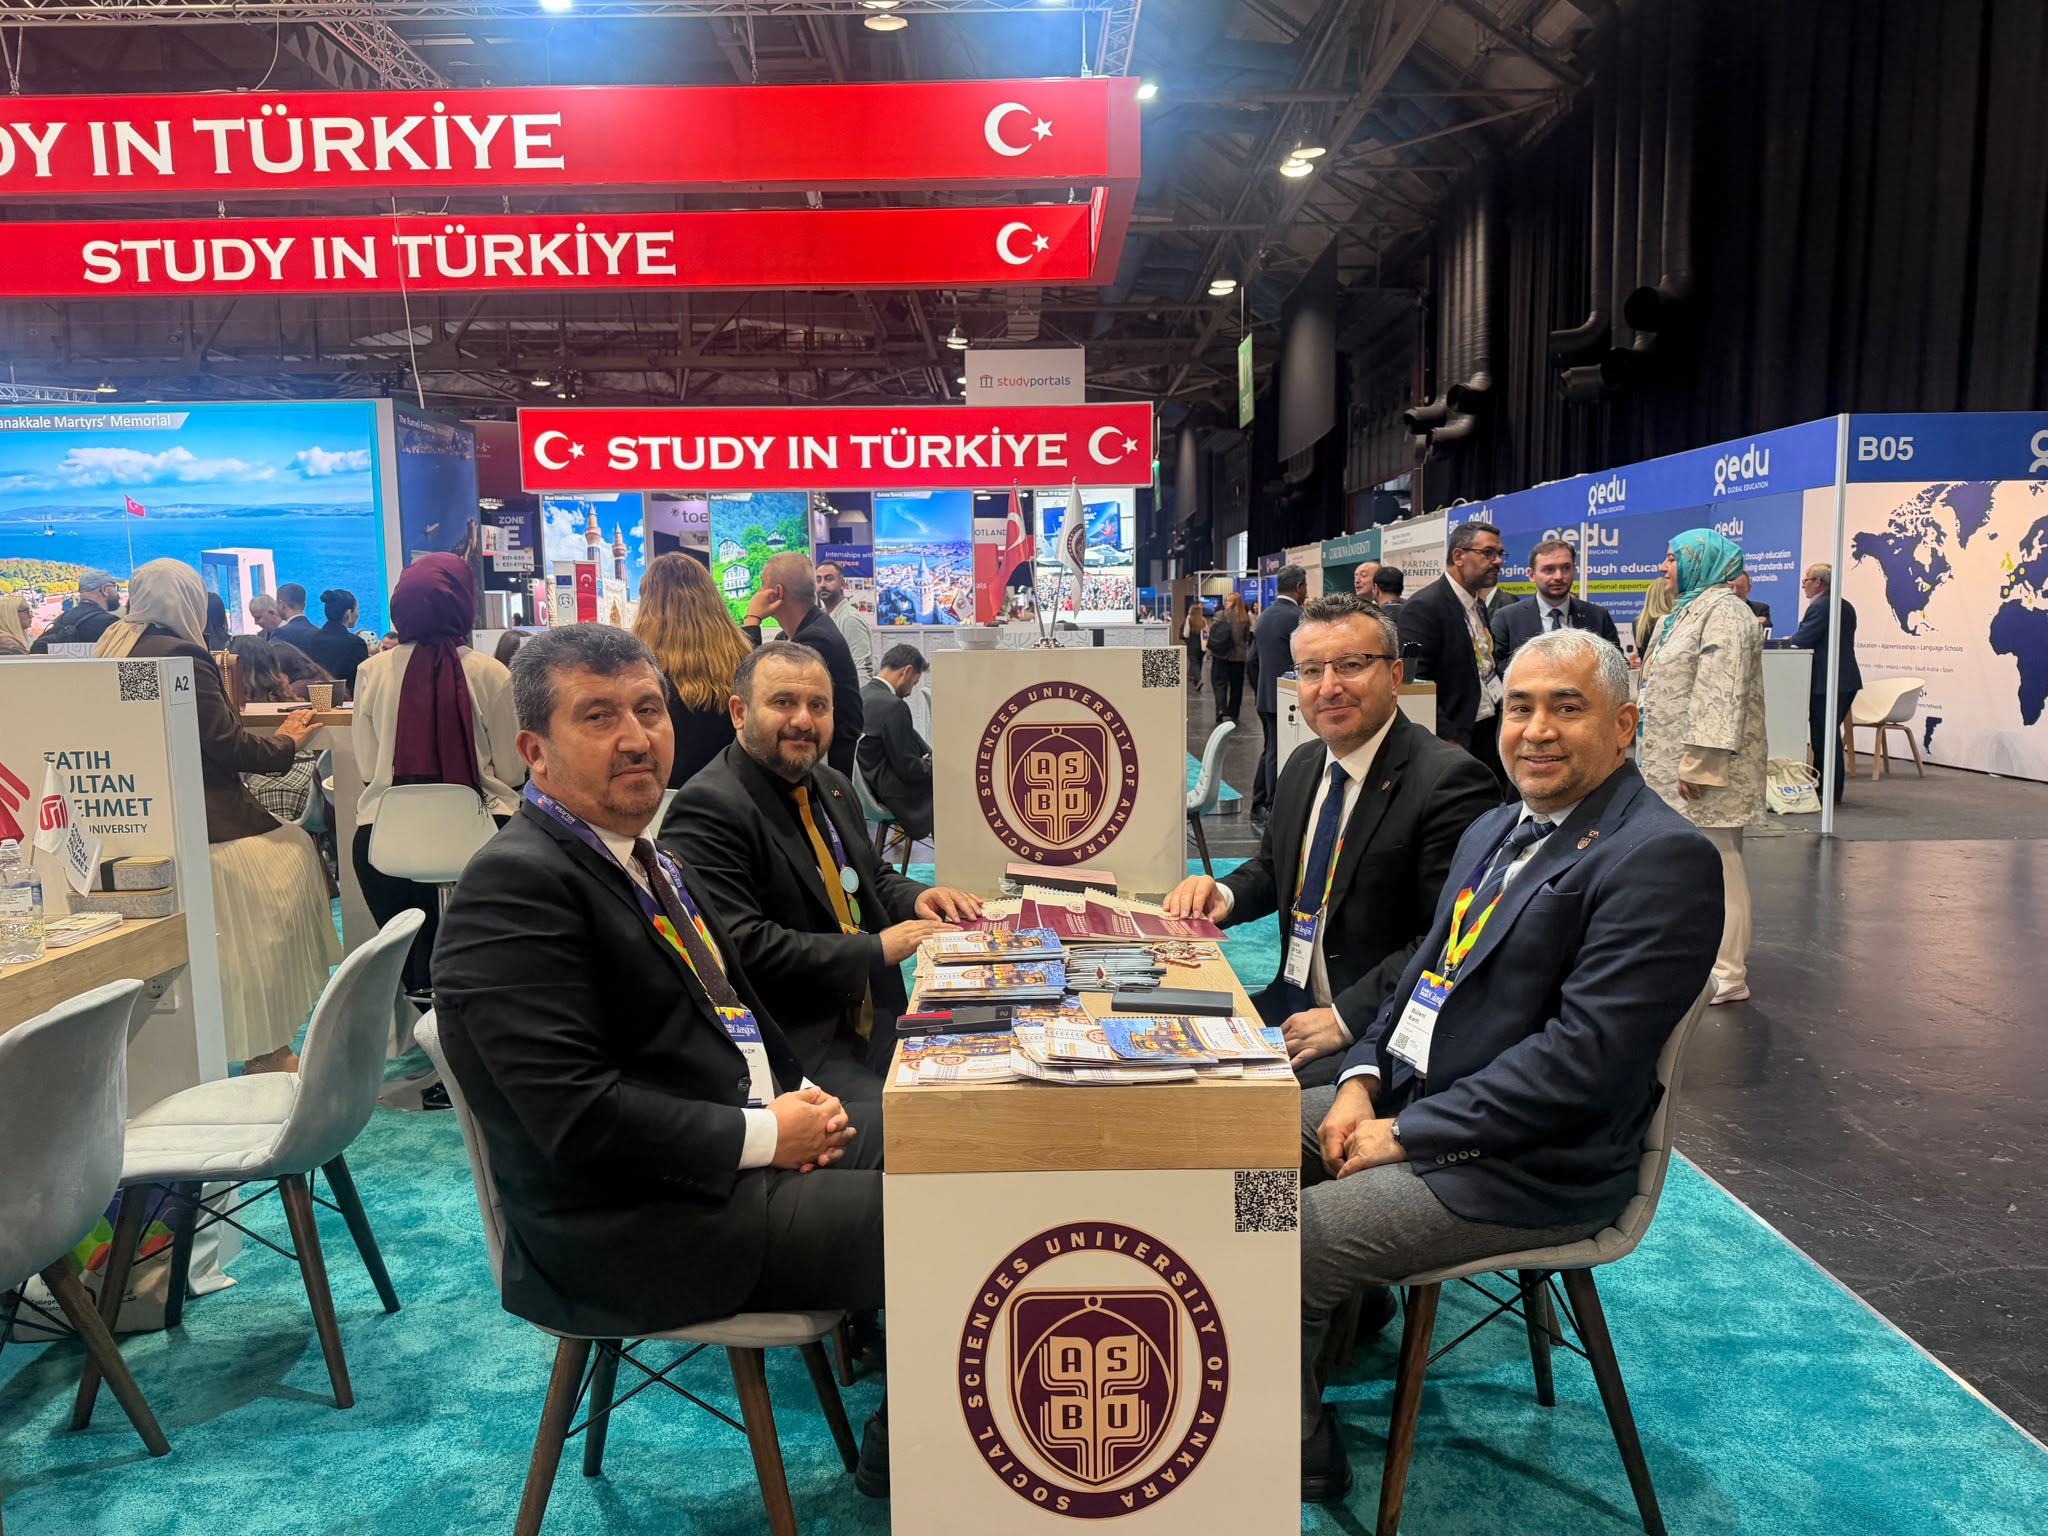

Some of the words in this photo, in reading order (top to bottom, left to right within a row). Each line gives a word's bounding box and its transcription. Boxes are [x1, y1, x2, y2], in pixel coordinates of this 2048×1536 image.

[88, 120, 176, 177] IN
[192, 100, 565, 175] TÜRKİYE
[81, 236, 296, 284] STUDY
[311, 235, 378, 280] IN
[391, 221, 677, 278] TÜRKİYE
[997, 375, 1072, 388] studyportals
[111, 413, 171, 428] Memorial
[607, 434, 776, 471] STUDY
[788, 434, 839, 469] IN
[850, 426, 1069, 470] TÜRKİYE
[1857, 435, 1915, 462] B05
[1713, 442, 1770, 497] gedu
[1587, 473, 1627, 517] gedu
[1727, 484, 1743, 494] GLOBAL
[1743, 480, 1769, 492] EDUCATION
[498, 516, 525, 525] ZONE
[504, 525, 521, 546] E
[825, 551, 861, 559] Internships
[1402, 559, 1439, 568] PARTNER
[1765, 550, 1792, 559] education
[1784, 560, 1795, 570] and
[1402, 568, 1442, 577] BENEFITS
[1880, 643, 1916, 651] Apprenticeships
[1920, 644, 1944, 653] Language
[1944, 644, 1963, 653] Schools
[174, 675, 190, 692] A2
[1027, 686, 1132, 752] UNIVERSITY
[43, 750, 112, 771] FATIH
[978, 703, 1019, 797] SCIENCES
[69, 773, 136, 794] ULTAN
[1125, 763, 1136, 787] OF
[88, 823, 148, 835] NIVERSITY
[987, 807, 1044, 862] SOCIAL
[1072, 798, 1132, 861] ANKARA
[1045, 1231, 1217, 1336] UNIVERSITY
[964, 1257, 1029, 1409] SCIENCES
[1206, 1356, 1223, 1392] OF
[978, 1425, 1072, 1511] SOCIAL
[1119, 1410, 1216, 1508] ANKARA
